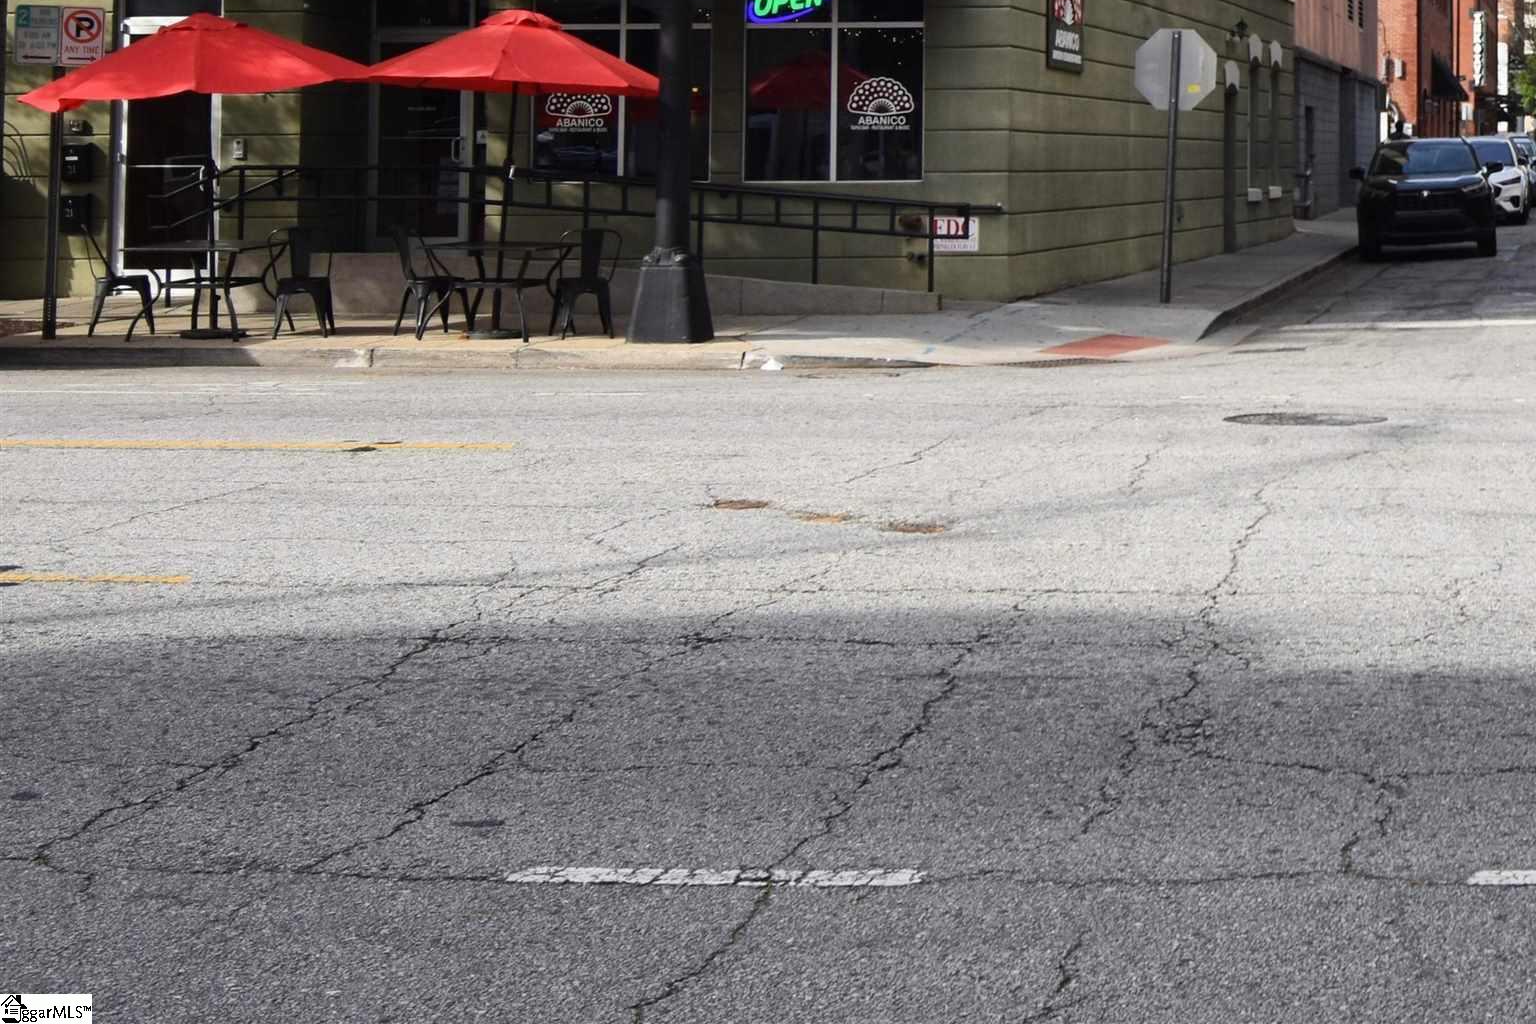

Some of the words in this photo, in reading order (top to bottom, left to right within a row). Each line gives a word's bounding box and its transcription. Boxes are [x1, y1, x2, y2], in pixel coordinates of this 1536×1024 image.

[64, 45, 80, 55] ANY
[82, 45, 99, 55] TIME
[556, 117, 604, 128] ABANICO
[858, 115, 906, 126] ABANICO
